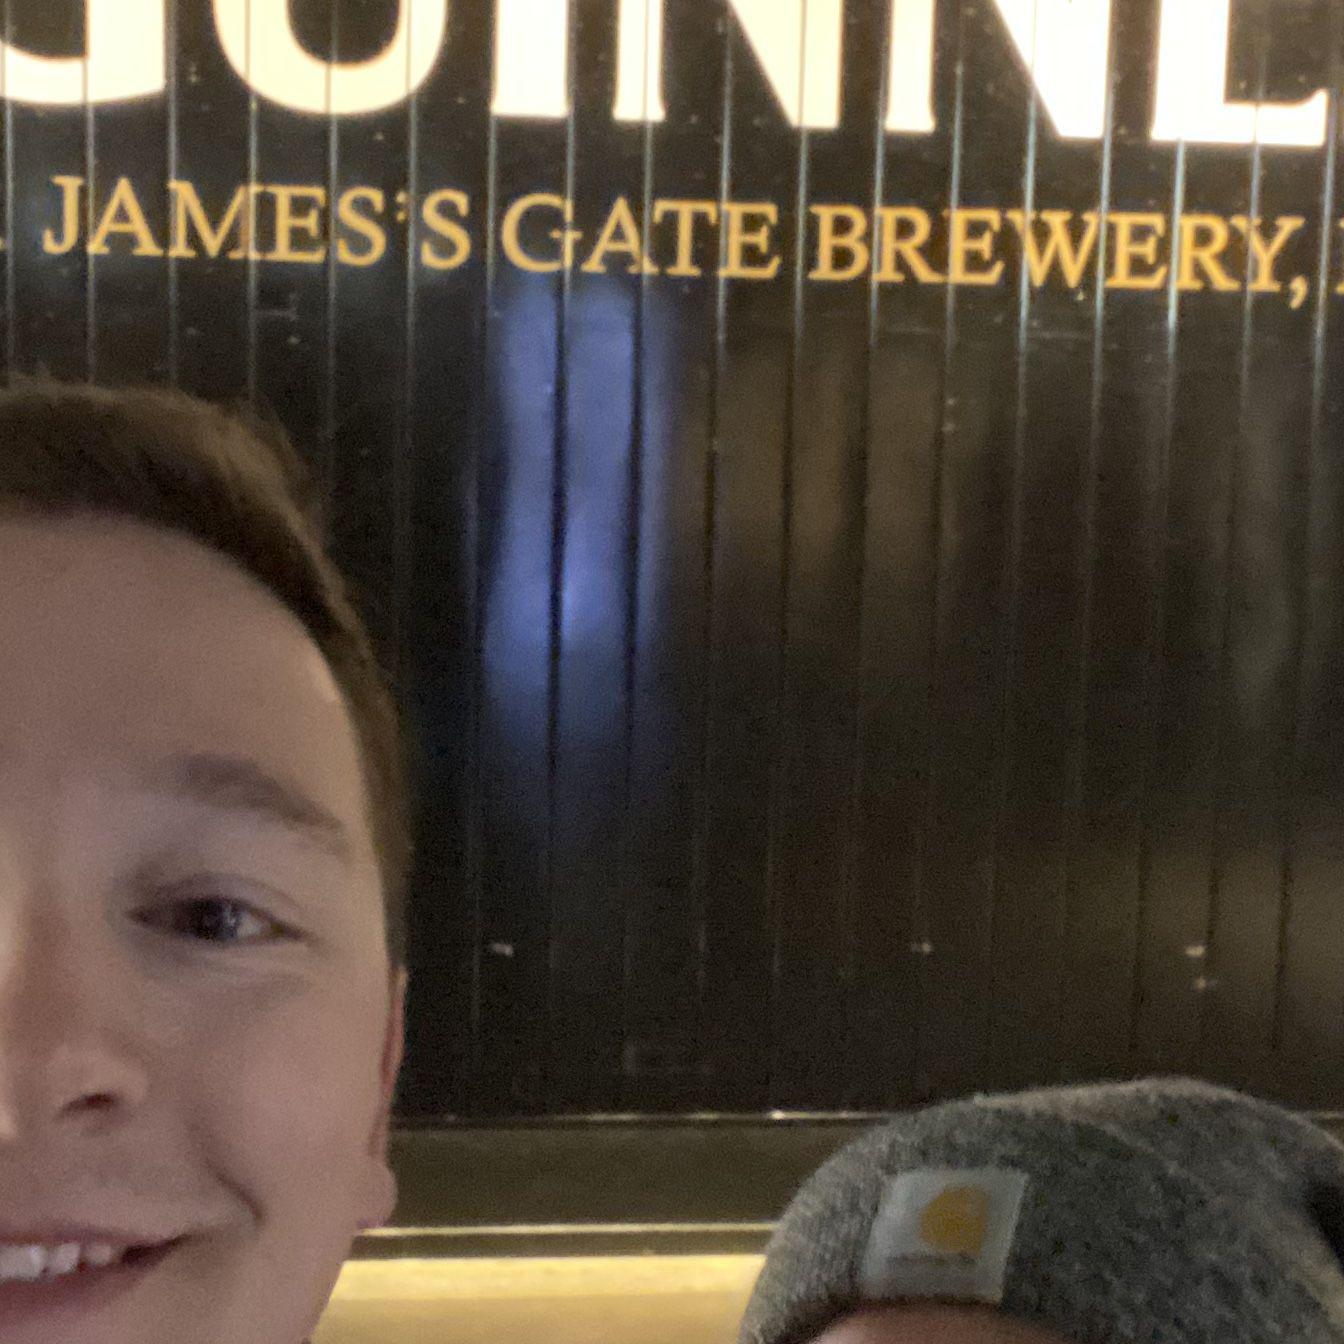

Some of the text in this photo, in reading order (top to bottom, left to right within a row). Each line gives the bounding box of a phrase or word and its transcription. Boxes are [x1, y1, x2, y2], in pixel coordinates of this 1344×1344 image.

[42, 174, 473, 270] JAMES'S
[500, 192, 782, 279] GATE
[808, 204, 1308, 309] BREWERY,
